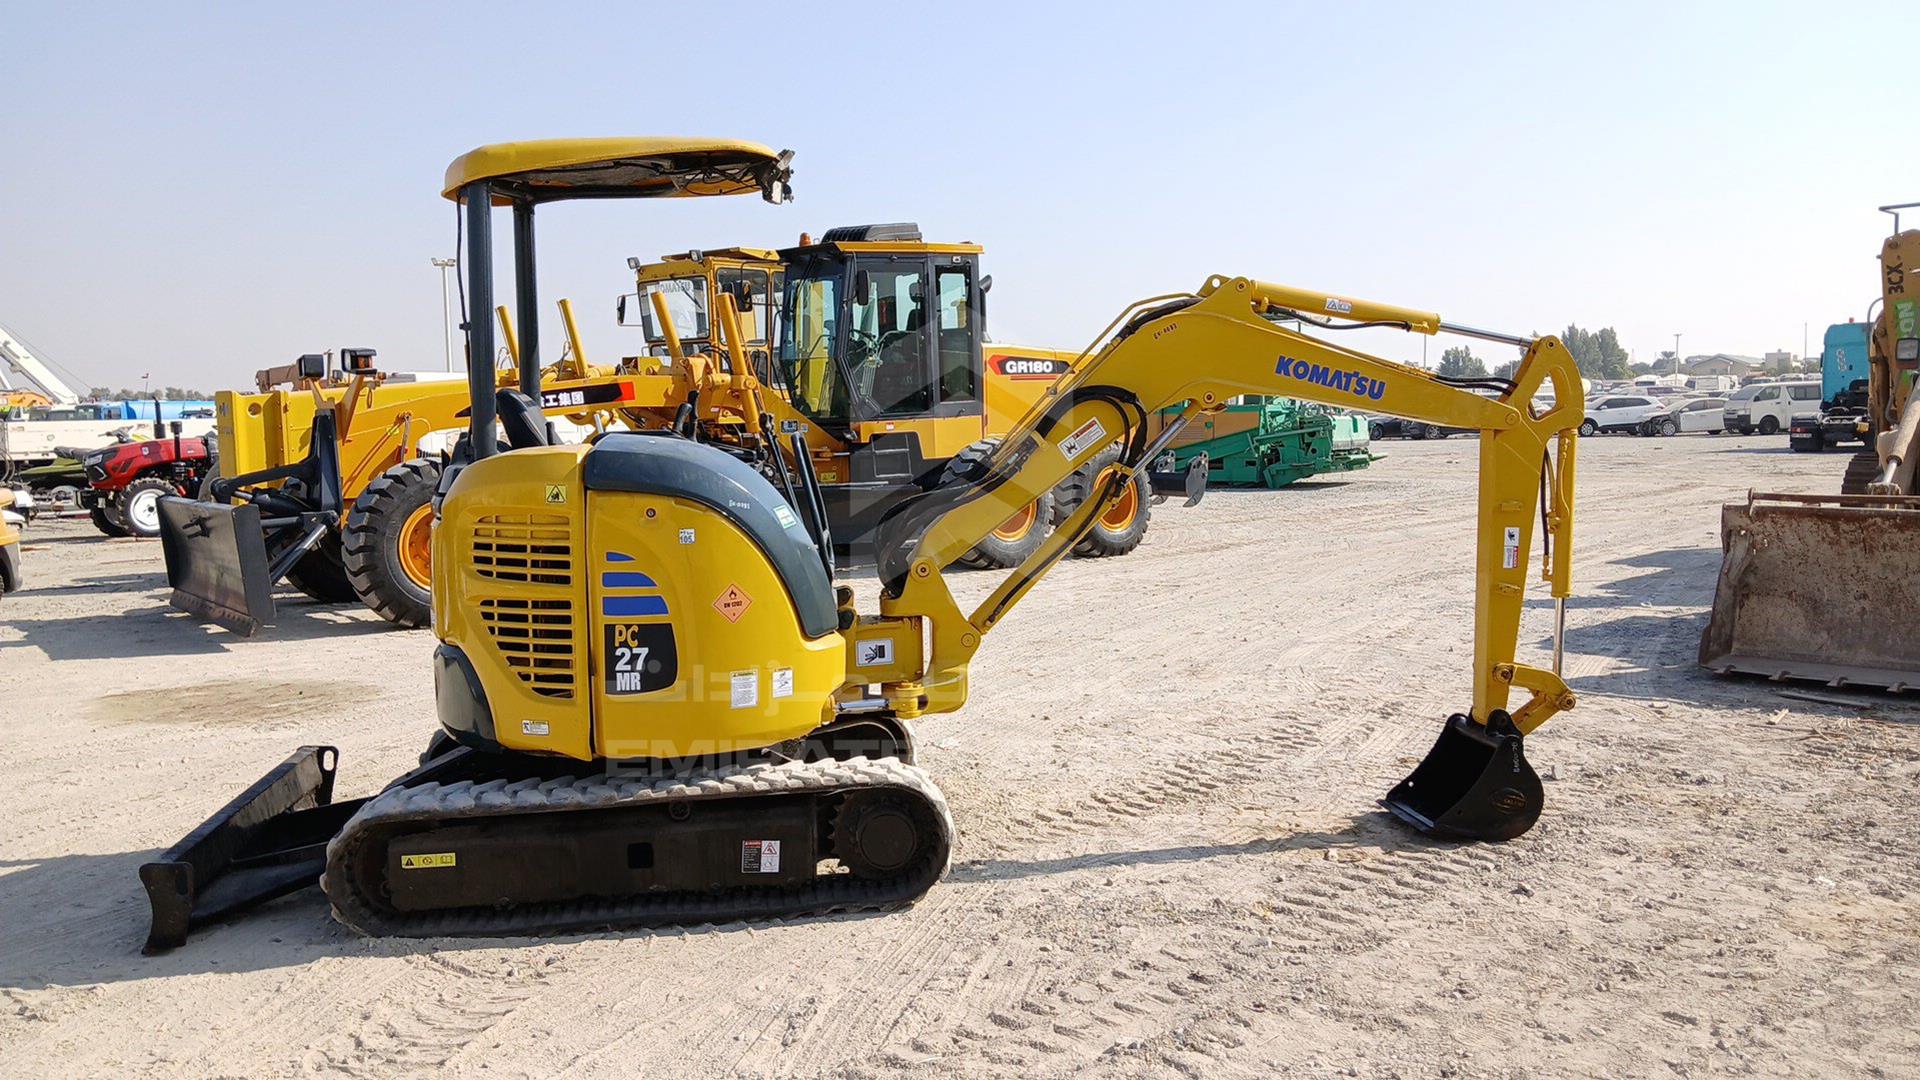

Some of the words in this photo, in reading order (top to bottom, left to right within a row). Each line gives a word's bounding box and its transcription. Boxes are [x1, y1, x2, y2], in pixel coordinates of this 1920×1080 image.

[1886, 262, 1905, 295] 3CX
[1005, 360, 1054, 374] GR180
[1275, 355, 1386, 400] KOMATSU
[613, 624, 640, 648] PC
[614, 647, 649, 672] 27
[615, 672, 642, 691] MR
